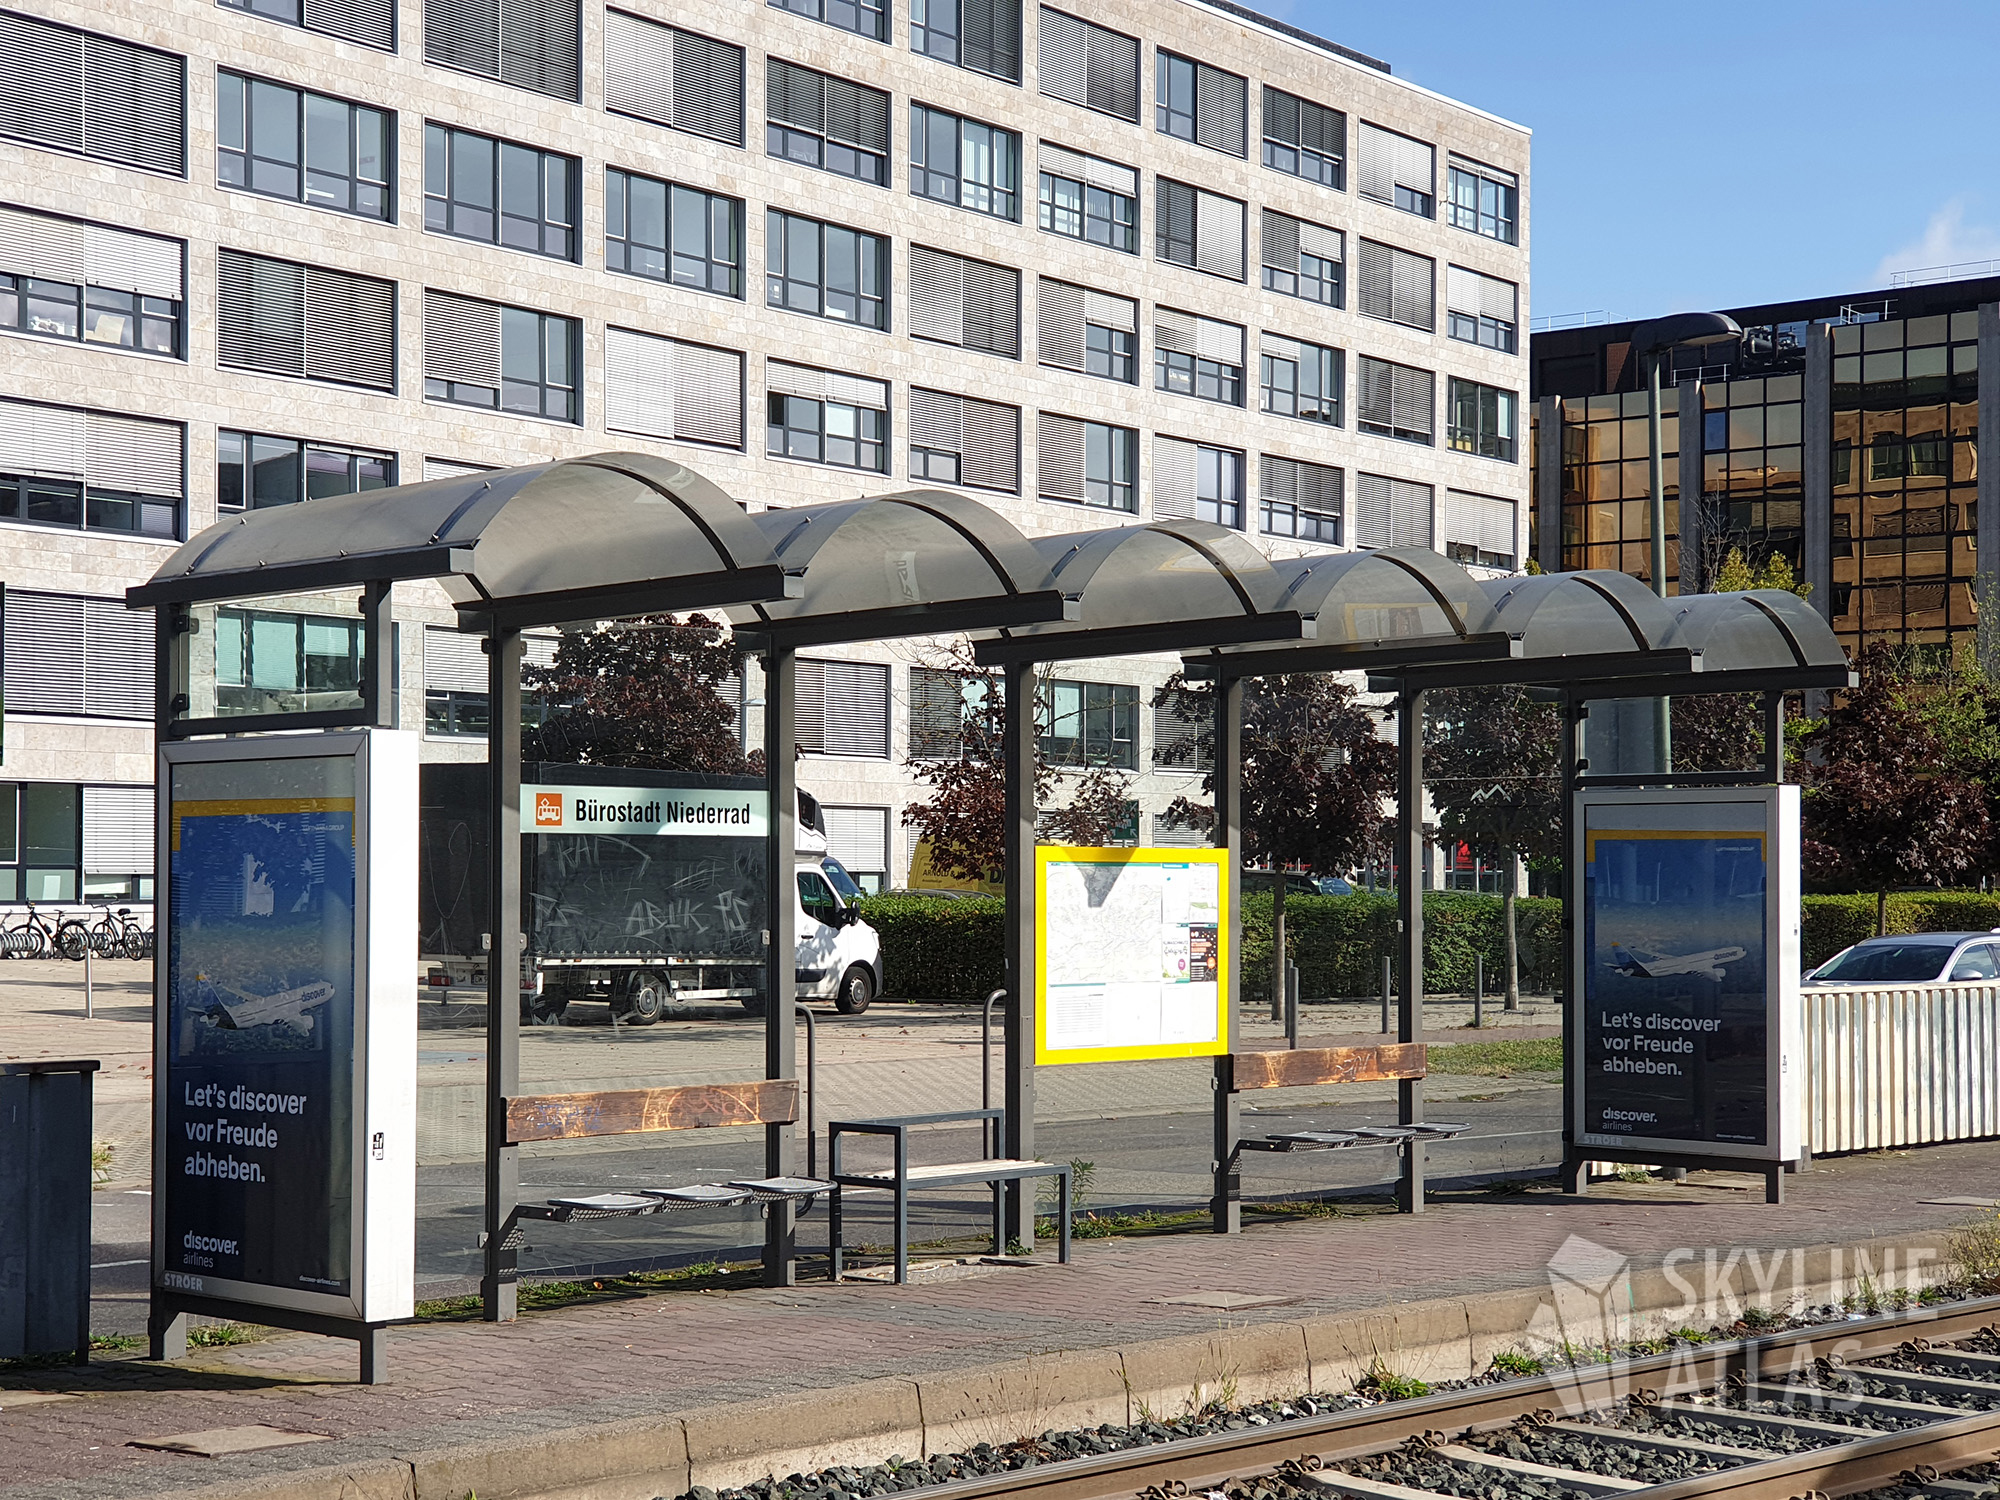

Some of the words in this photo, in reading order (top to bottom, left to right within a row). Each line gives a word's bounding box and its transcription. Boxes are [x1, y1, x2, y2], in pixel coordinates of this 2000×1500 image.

[576, 799, 661, 824] Bürostadt
[667, 801, 750, 825] Niederrad
[1602, 1011, 1643, 1029] Let's
[1645, 1013, 1721, 1032] discover
[1602, 1036, 1630, 1050] vor
[1633, 1035, 1694, 1054] Freude
[1602, 1057, 1682, 1076] abheben.
[185, 1081, 226, 1109] Let's
[229, 1085, 307, 1115] discover
[1602, 1107, 1658, 1123] discover.
[185, 1121, 214, 1142] vor
[217, 1119, 278, 1149] Freude
[1602, 1121, 1633, 1132] airlines
[184, 1151, 266, 1183] abheben.
[183, 1230, 240, 1256] discover.
[183, 1252, 214, 1268] airlines
